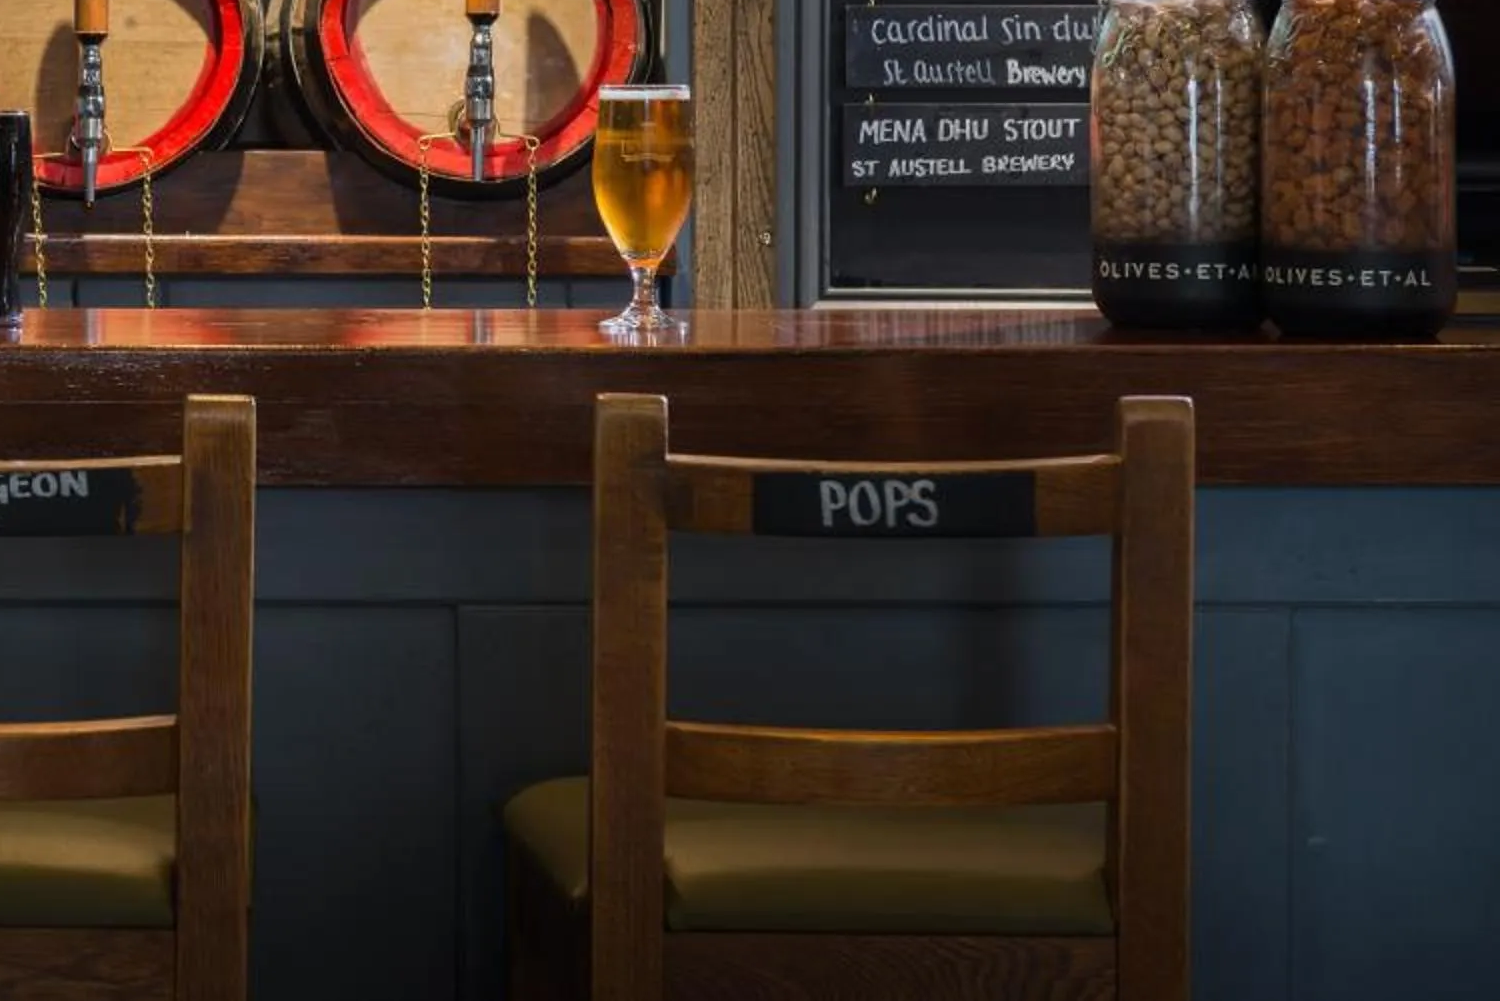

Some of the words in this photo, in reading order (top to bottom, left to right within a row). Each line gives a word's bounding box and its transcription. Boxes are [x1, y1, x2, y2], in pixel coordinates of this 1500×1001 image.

[1000, 14, 1042, 45] Sin
[1052, 13, 1098, 42] du
[883, 59, 907, 86] St
[1006, 59, 1086, 87] Brewery
[859, 118, 927, 144] MENA
[938, 118, 989, 142] DHU
[1003, 118, 1082, 141] STOUT
[851, 160, 880, 178] ST
[888, 158, 972, 178] AUSTELL
[982, 155, 1075, 174] BREWERY
[819, 479, 938, 528] POPS
